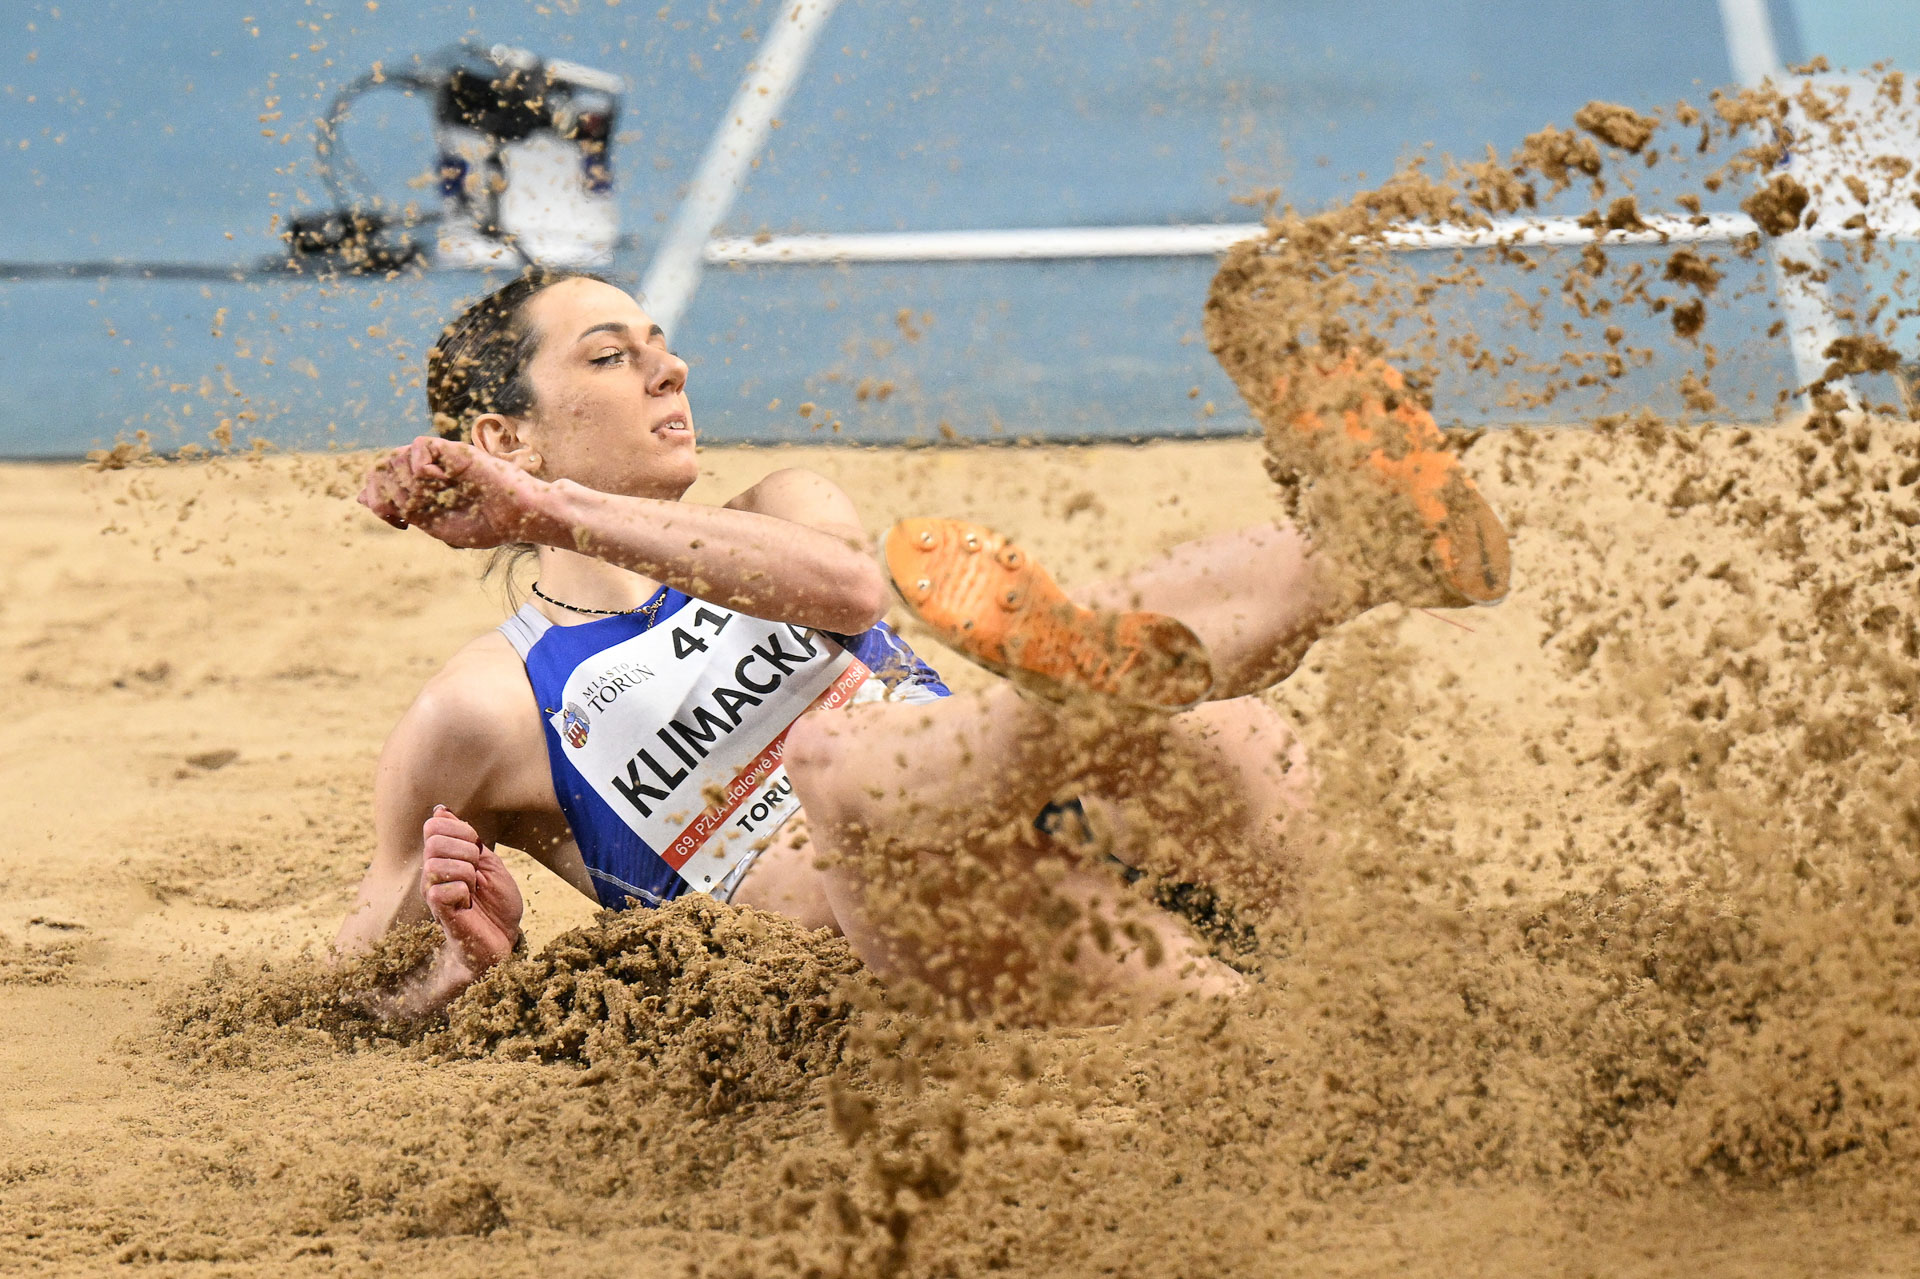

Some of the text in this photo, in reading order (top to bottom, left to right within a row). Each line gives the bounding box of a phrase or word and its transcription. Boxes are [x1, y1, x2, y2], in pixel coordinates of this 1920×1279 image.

[672, 607, 733, 660] 41
[582, 662, 630, 699] MIASTO
[588, 663, 656, 714] TORUŃ
[675, 835, 700, 856] 69.
[694, 806, 727, 836] PZLA
[727, 758, 773, 806] Halowe
[768, 740, 786, 761] Mi
[838, 662, 866, 695] Polski
[736, 775, 793, 833] TORU
